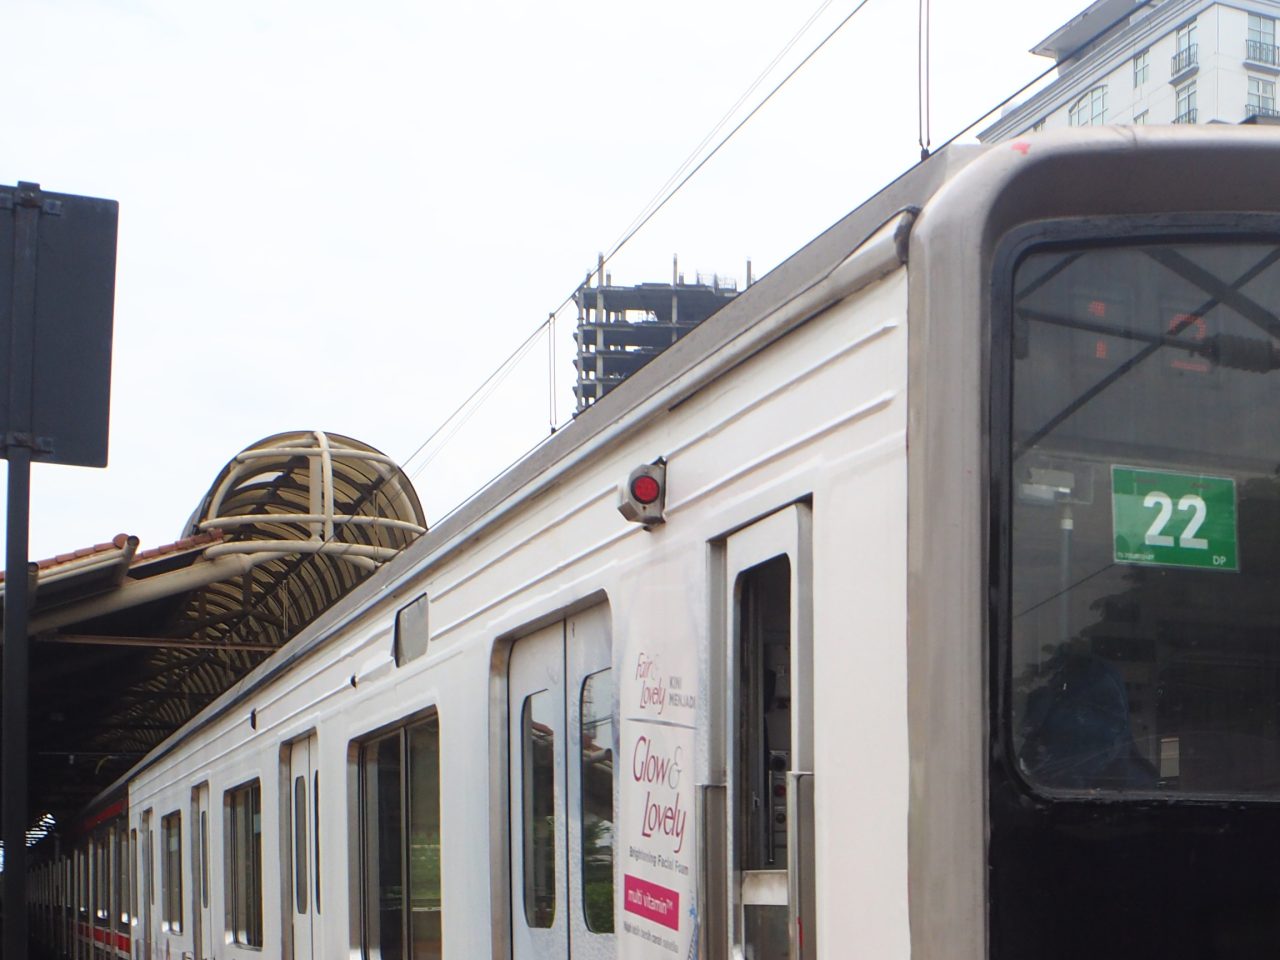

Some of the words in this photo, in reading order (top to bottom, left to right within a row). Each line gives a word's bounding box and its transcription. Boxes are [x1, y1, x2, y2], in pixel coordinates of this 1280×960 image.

[1143, 490, 1209, 550] 22
[1212, 555, 1227, 566] DP
[640, 677, 666, 715] Lovely
[642, 791, 686, 854] Lovely
